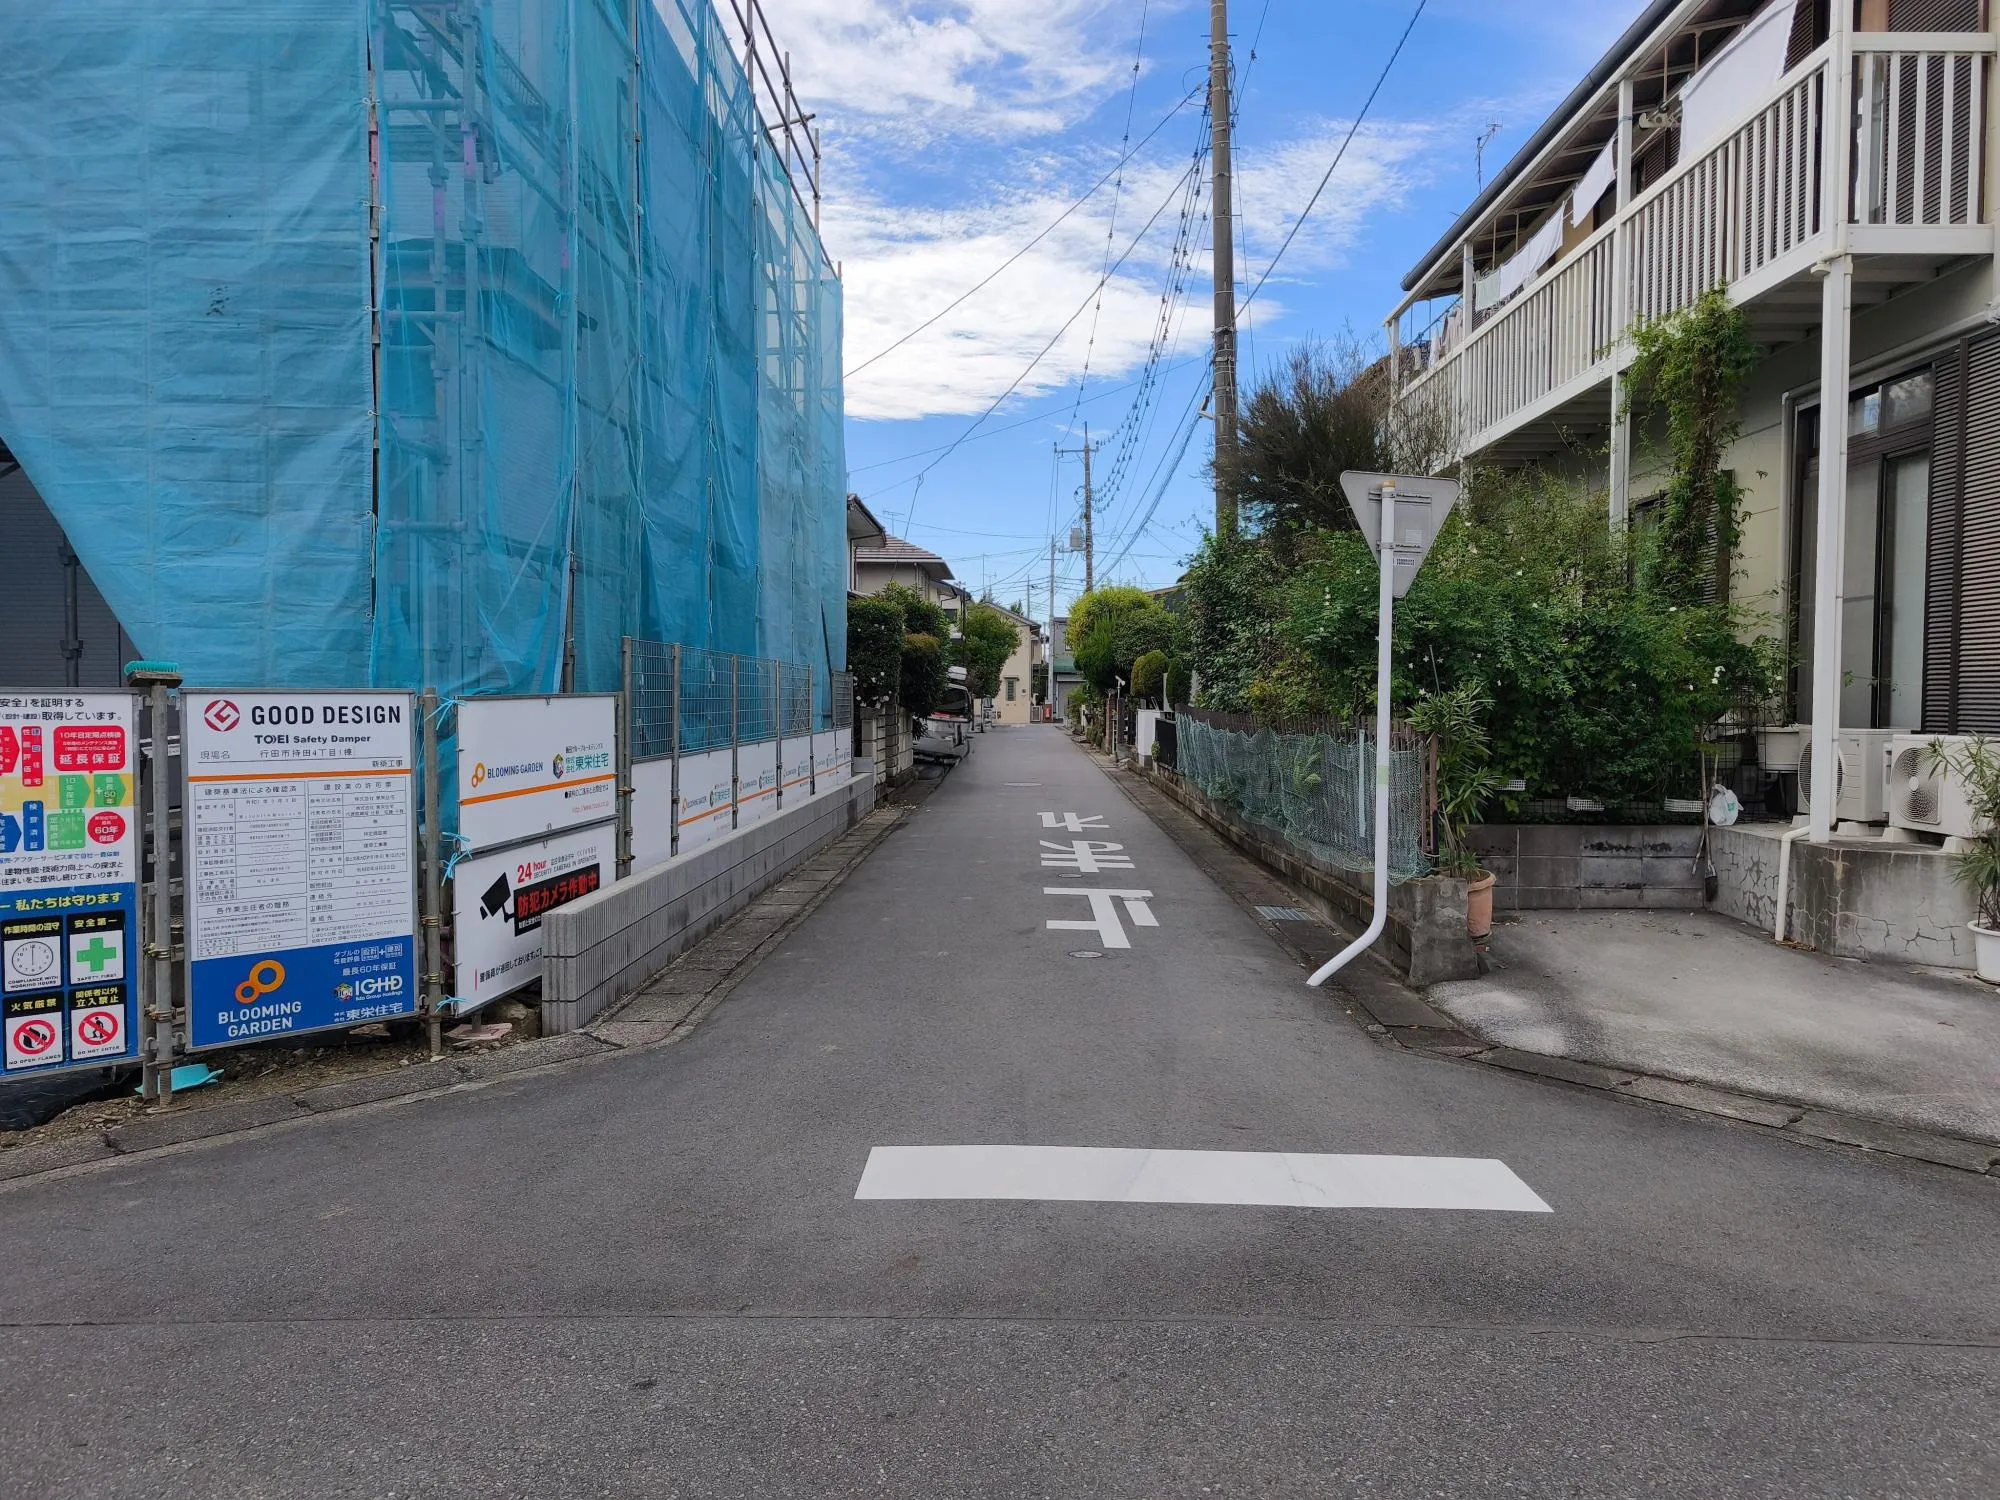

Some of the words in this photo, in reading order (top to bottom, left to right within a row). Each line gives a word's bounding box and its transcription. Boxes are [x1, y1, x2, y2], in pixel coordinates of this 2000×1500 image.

[252, 705, 314, 726] GOOD
[323, 705, 401, 725] DESIGN
[293, 735, 328, 746] Safety
[331, 735, 371, 744] Damper
[60, 753, 120, 765] 延長保証
[200, 751, 230, 760] 現場名
[575, 752, 609, 773] 東栄住宅
[487, 764, 519, 779] BLOOMING
[520, 761, 544, 775] GARDEN
[517, 862, 532, 884] 24
[533, 860, 547, 871] hour
[1037, 812, 1160, 948] 止まれ
[16, 891, 122, 912] 私たちは守ります
[517, 871, 598, 918] 防犯カメラ作動中
[74, 917, 118, 928] 安全第一
[343, 961, 396, 977] 最長60年保証
[75, 987, 118, 999] 関係者以外
[76, 996, 119, 1008] 立入禁止
[11, 998, 57, 1012] 火気厳禁
[218, 1001, 302, 1025] BLOOMING
[346, 1002, 403, 1021] 東栄住宅
[228, 1016, 293, 1038] GARDEN
